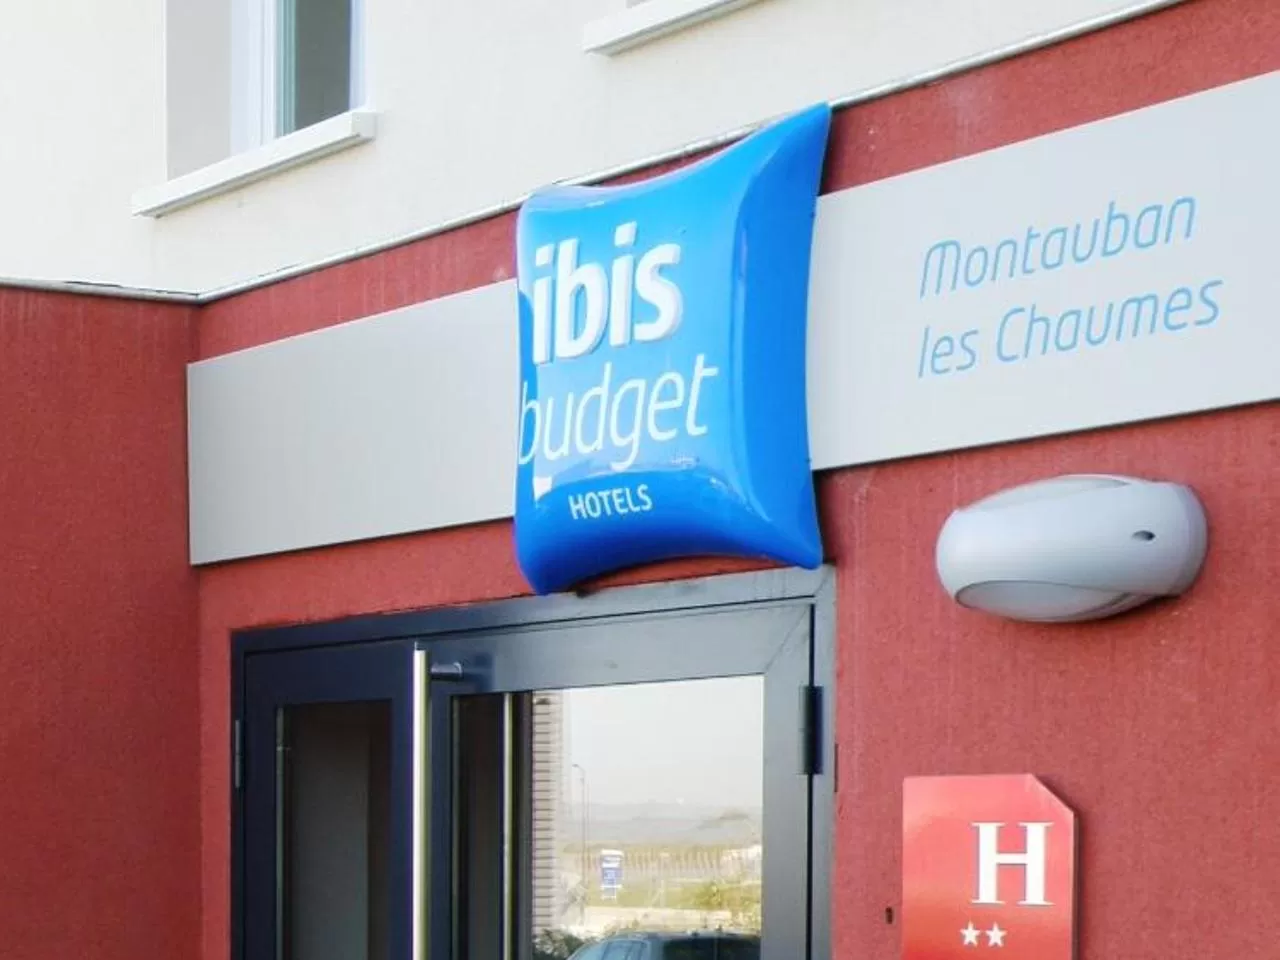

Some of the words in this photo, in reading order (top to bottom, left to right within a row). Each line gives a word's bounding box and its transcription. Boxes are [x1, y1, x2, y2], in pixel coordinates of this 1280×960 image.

[532, 221, 684, 366] ibis
[919, 196, 1196, 299] Montauban
[918, 325, 979, 379] les
[996, 279, 1224, 363] Chaumes
[518, 353, 718, 472] budget
[568, 483, 654, 520] HOTELS
[971, 821, 1056, 906] H
